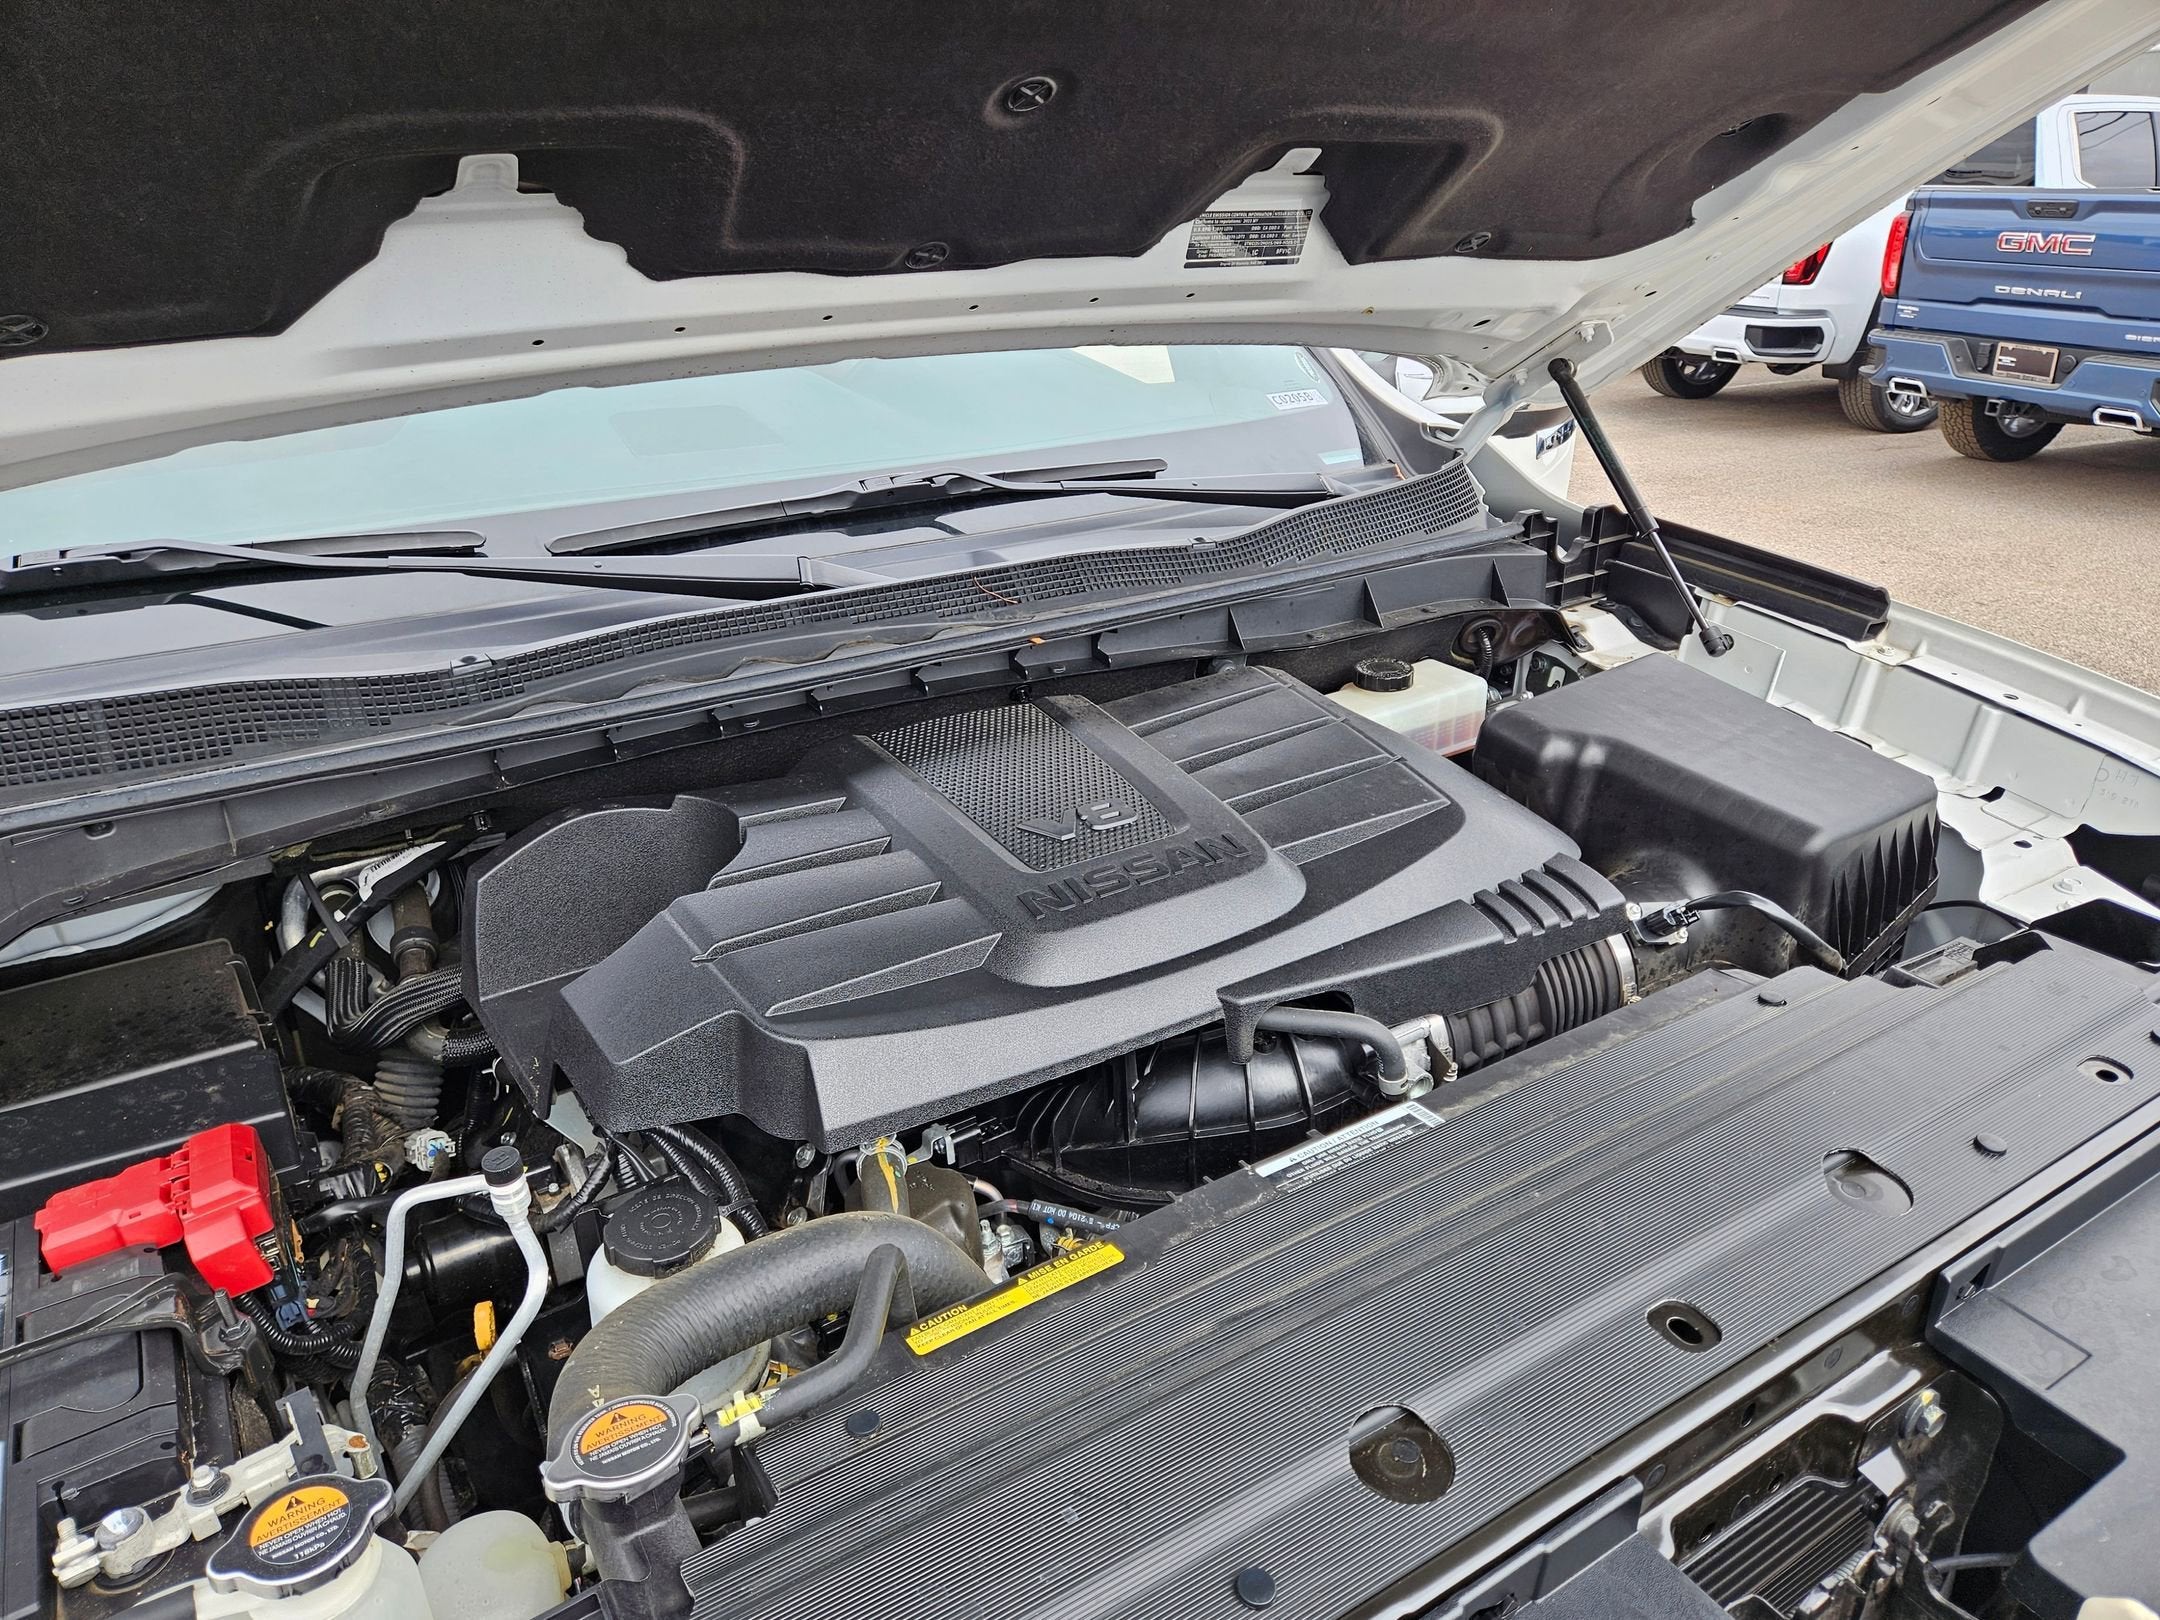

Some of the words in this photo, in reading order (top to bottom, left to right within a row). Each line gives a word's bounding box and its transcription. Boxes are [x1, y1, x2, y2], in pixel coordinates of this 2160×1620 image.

[1997, 231, 2096, 256] GMC
[1995, 285, 2082, 299] DENALI
[1016, 801, 1139, 842] V8
[1016, 832, 1251, 920] NISSAN
[1295, 1140, 1333, 1159] CAUTION
[1335, 1119, 1380, 1141] ATTENTION
[1026, 1263, 1054, 1280] MISE
[1052, 1256, 1069, 1268] EN
[1068, 1240, 1105, 1261] GARDE
[918, 1303, 967, 1331] CAUTION
[585, 1415, 661, 1449] AVERTISSEMENT
[589, 1444, 610, 1455] NEVER
[611, 1437, 628, 1446] OPEN
[629, 1428, 648, 1439] WHEN
[649, 1422, 663, 1431] HOT.
[595, 1413, 646, 1438] WARNING
[589, 1454, 599, 1462] NE
[598, 1446, 619, 1458] JAMAIS
[619, 1437, 641, 1449] OUVRIR
[645, 1426, 667, 1438] CHAUD.
[255, 1498, 342, 1542] AVERTISSEMENT
[259, 1535, 282, 1549] NEVER
[283, 1526, 304, 1538] OPEN
[304, 1515, 327, 1528] WHEN
[327, 1507, 343, 1517] HOT.
[267, 1496, 325, 1528] WARNING
[258, 1548, 269, 1556] NE
[268, 1537, 292, 1551] JAMAIS
[292, 1526, 317, 1540] OUVRIR
[322, 1511, 347, 1526] CHAUD.
[271, 1546, 293, 1558] NISSAN
[294, 1536, 315, 1548] MOTOR
